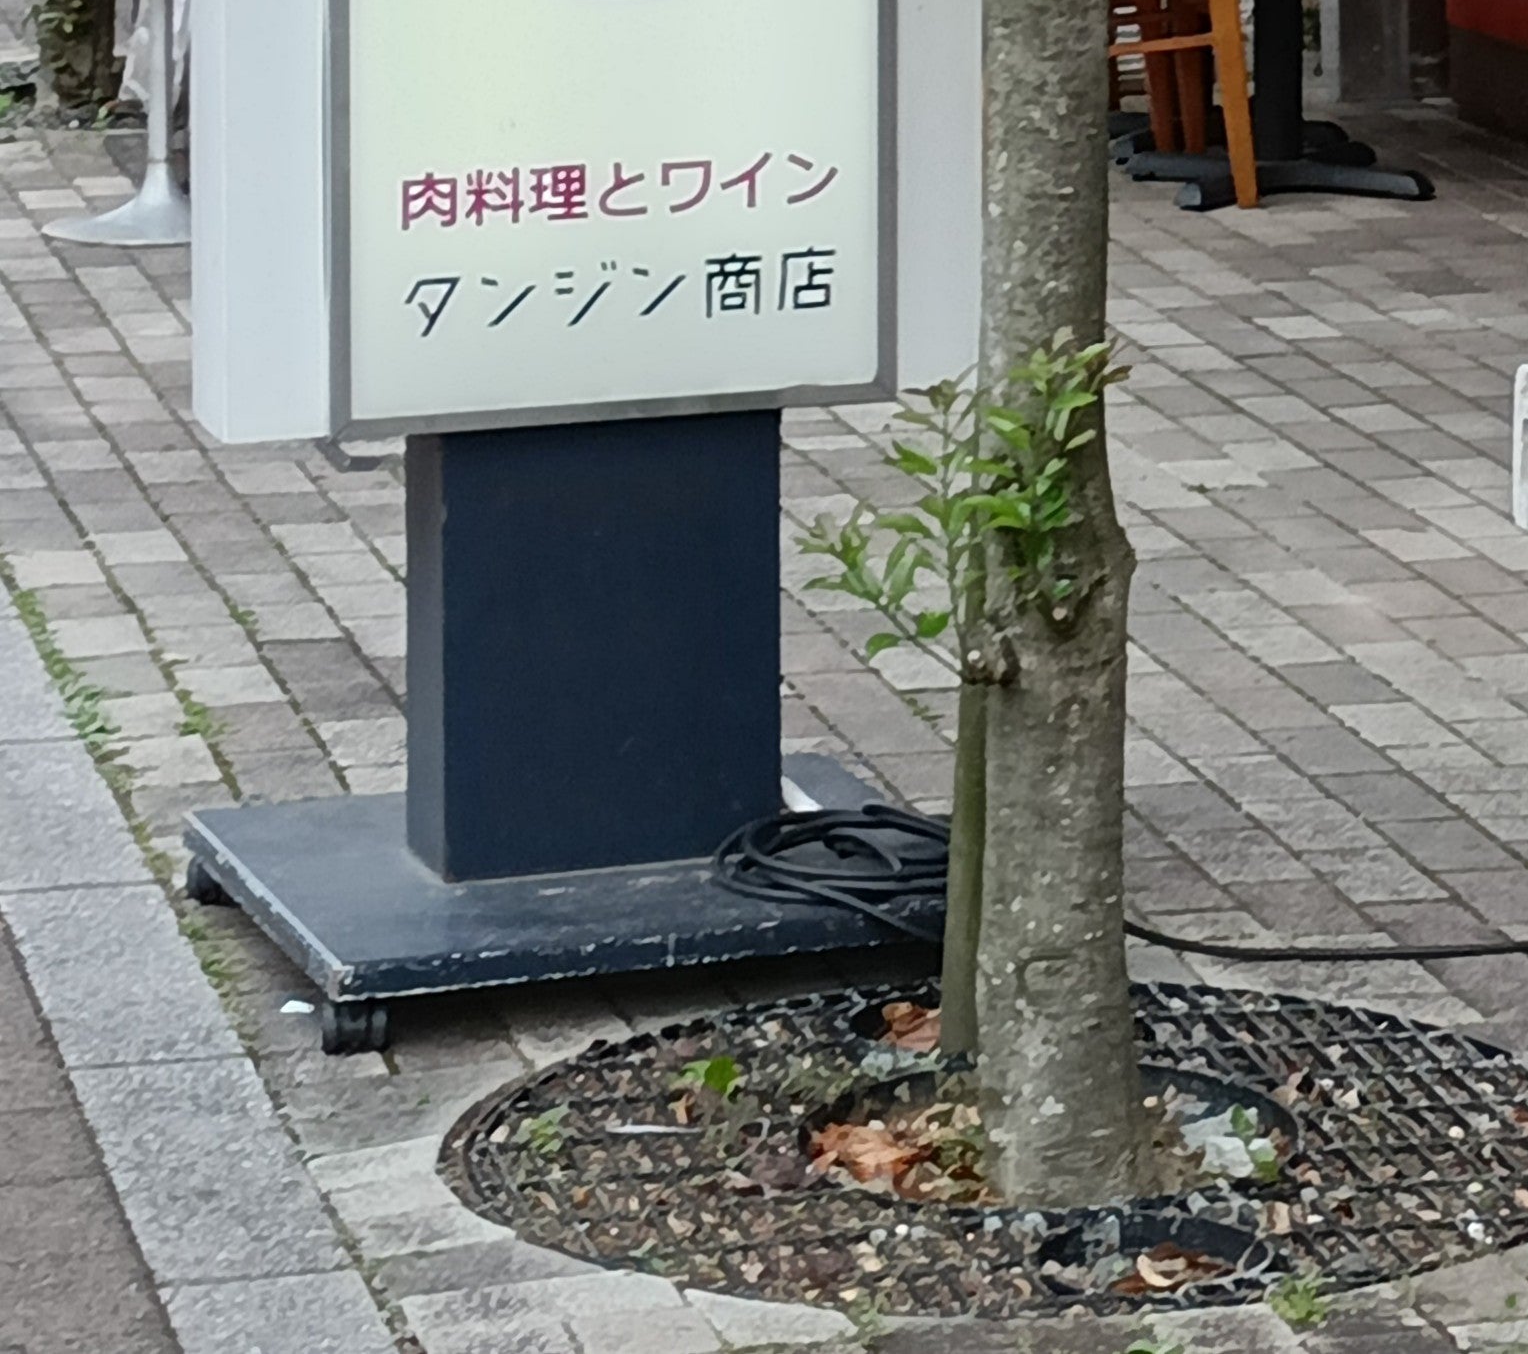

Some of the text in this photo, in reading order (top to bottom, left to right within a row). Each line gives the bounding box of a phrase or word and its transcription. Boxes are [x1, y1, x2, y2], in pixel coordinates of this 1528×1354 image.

[400, 151, 840, 231] 肉料理とワイン
[404, 246, 838, 338] タンジン商店
